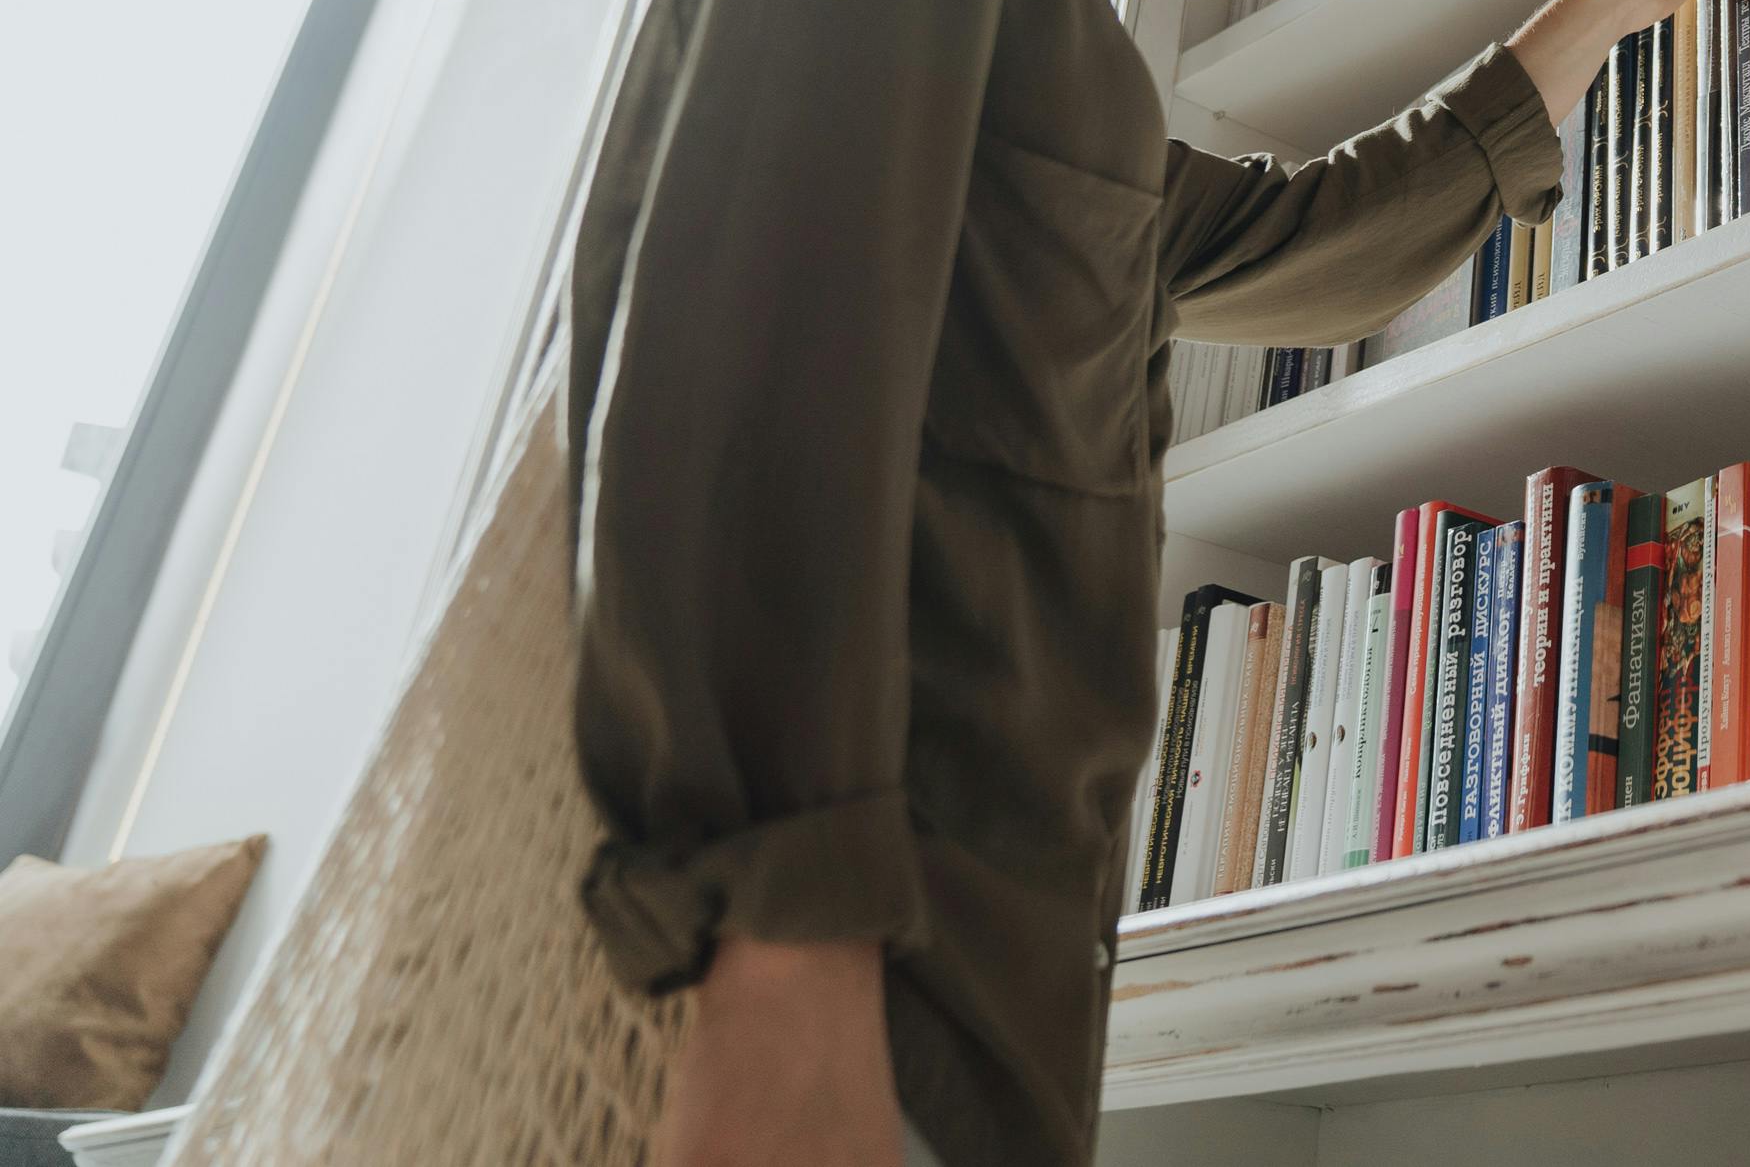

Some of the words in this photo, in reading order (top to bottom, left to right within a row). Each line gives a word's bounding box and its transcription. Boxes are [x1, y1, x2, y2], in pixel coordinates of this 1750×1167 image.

[1740, 16, 1750, 53] Театры
[1592, 206, 1602, 232] Эрих
[1593, 163, 1602, 206] ФРОММ
[1536, 481, 1557, 585] практики
[1701, 496, 1715, 624] коммуникация
[1447, 530, 1473, 638] разговор
[1473, 540, 1492, 638] ДИСКУРС
[1535, 587, 1551, 604] и
[1723, 596, 1732, 633] самости
[1495, 607, 1511, 695] ДИАЛОГ
[1530, 606, 1550, 686] теории
[1559, 573, 1585, 792] КОММУНИКАЦИИ
[1624, 586, 1646, 729] Фанатизм
[1722, 633, 1731, 665] Анализ
[1170, 726, 1185, 785] ЛИЧНОСТЬ
[1179, 678, 1192, 722] НАШЕГО
[1186, 625, 1199, 674] ВРЕМЕНИ
[1285, 700, 1300, 763] ИНФАРКТА
[1433, 649, 1463, 825] Повседневный
[1464, 650, 1486, 819] РАЗГОВОРНЫЙ
[1654, 687, 1672, 797] Эффект
[1698, 631, 1712, 762] Продуктивная
[1217, 819, 1232, 879] ТЕРАПИЯ
[1226, 691, 1249, 814] ЭМОЦИОНАЛЬНЫХ
[1243, 650, 1255, 687] СХЕМ
[1279, 767, 1292, 813] БЫВАЕТ
[1517, 732, 1533, 804] Гриффин
[1276, 817, 1286, 832] НЕ
